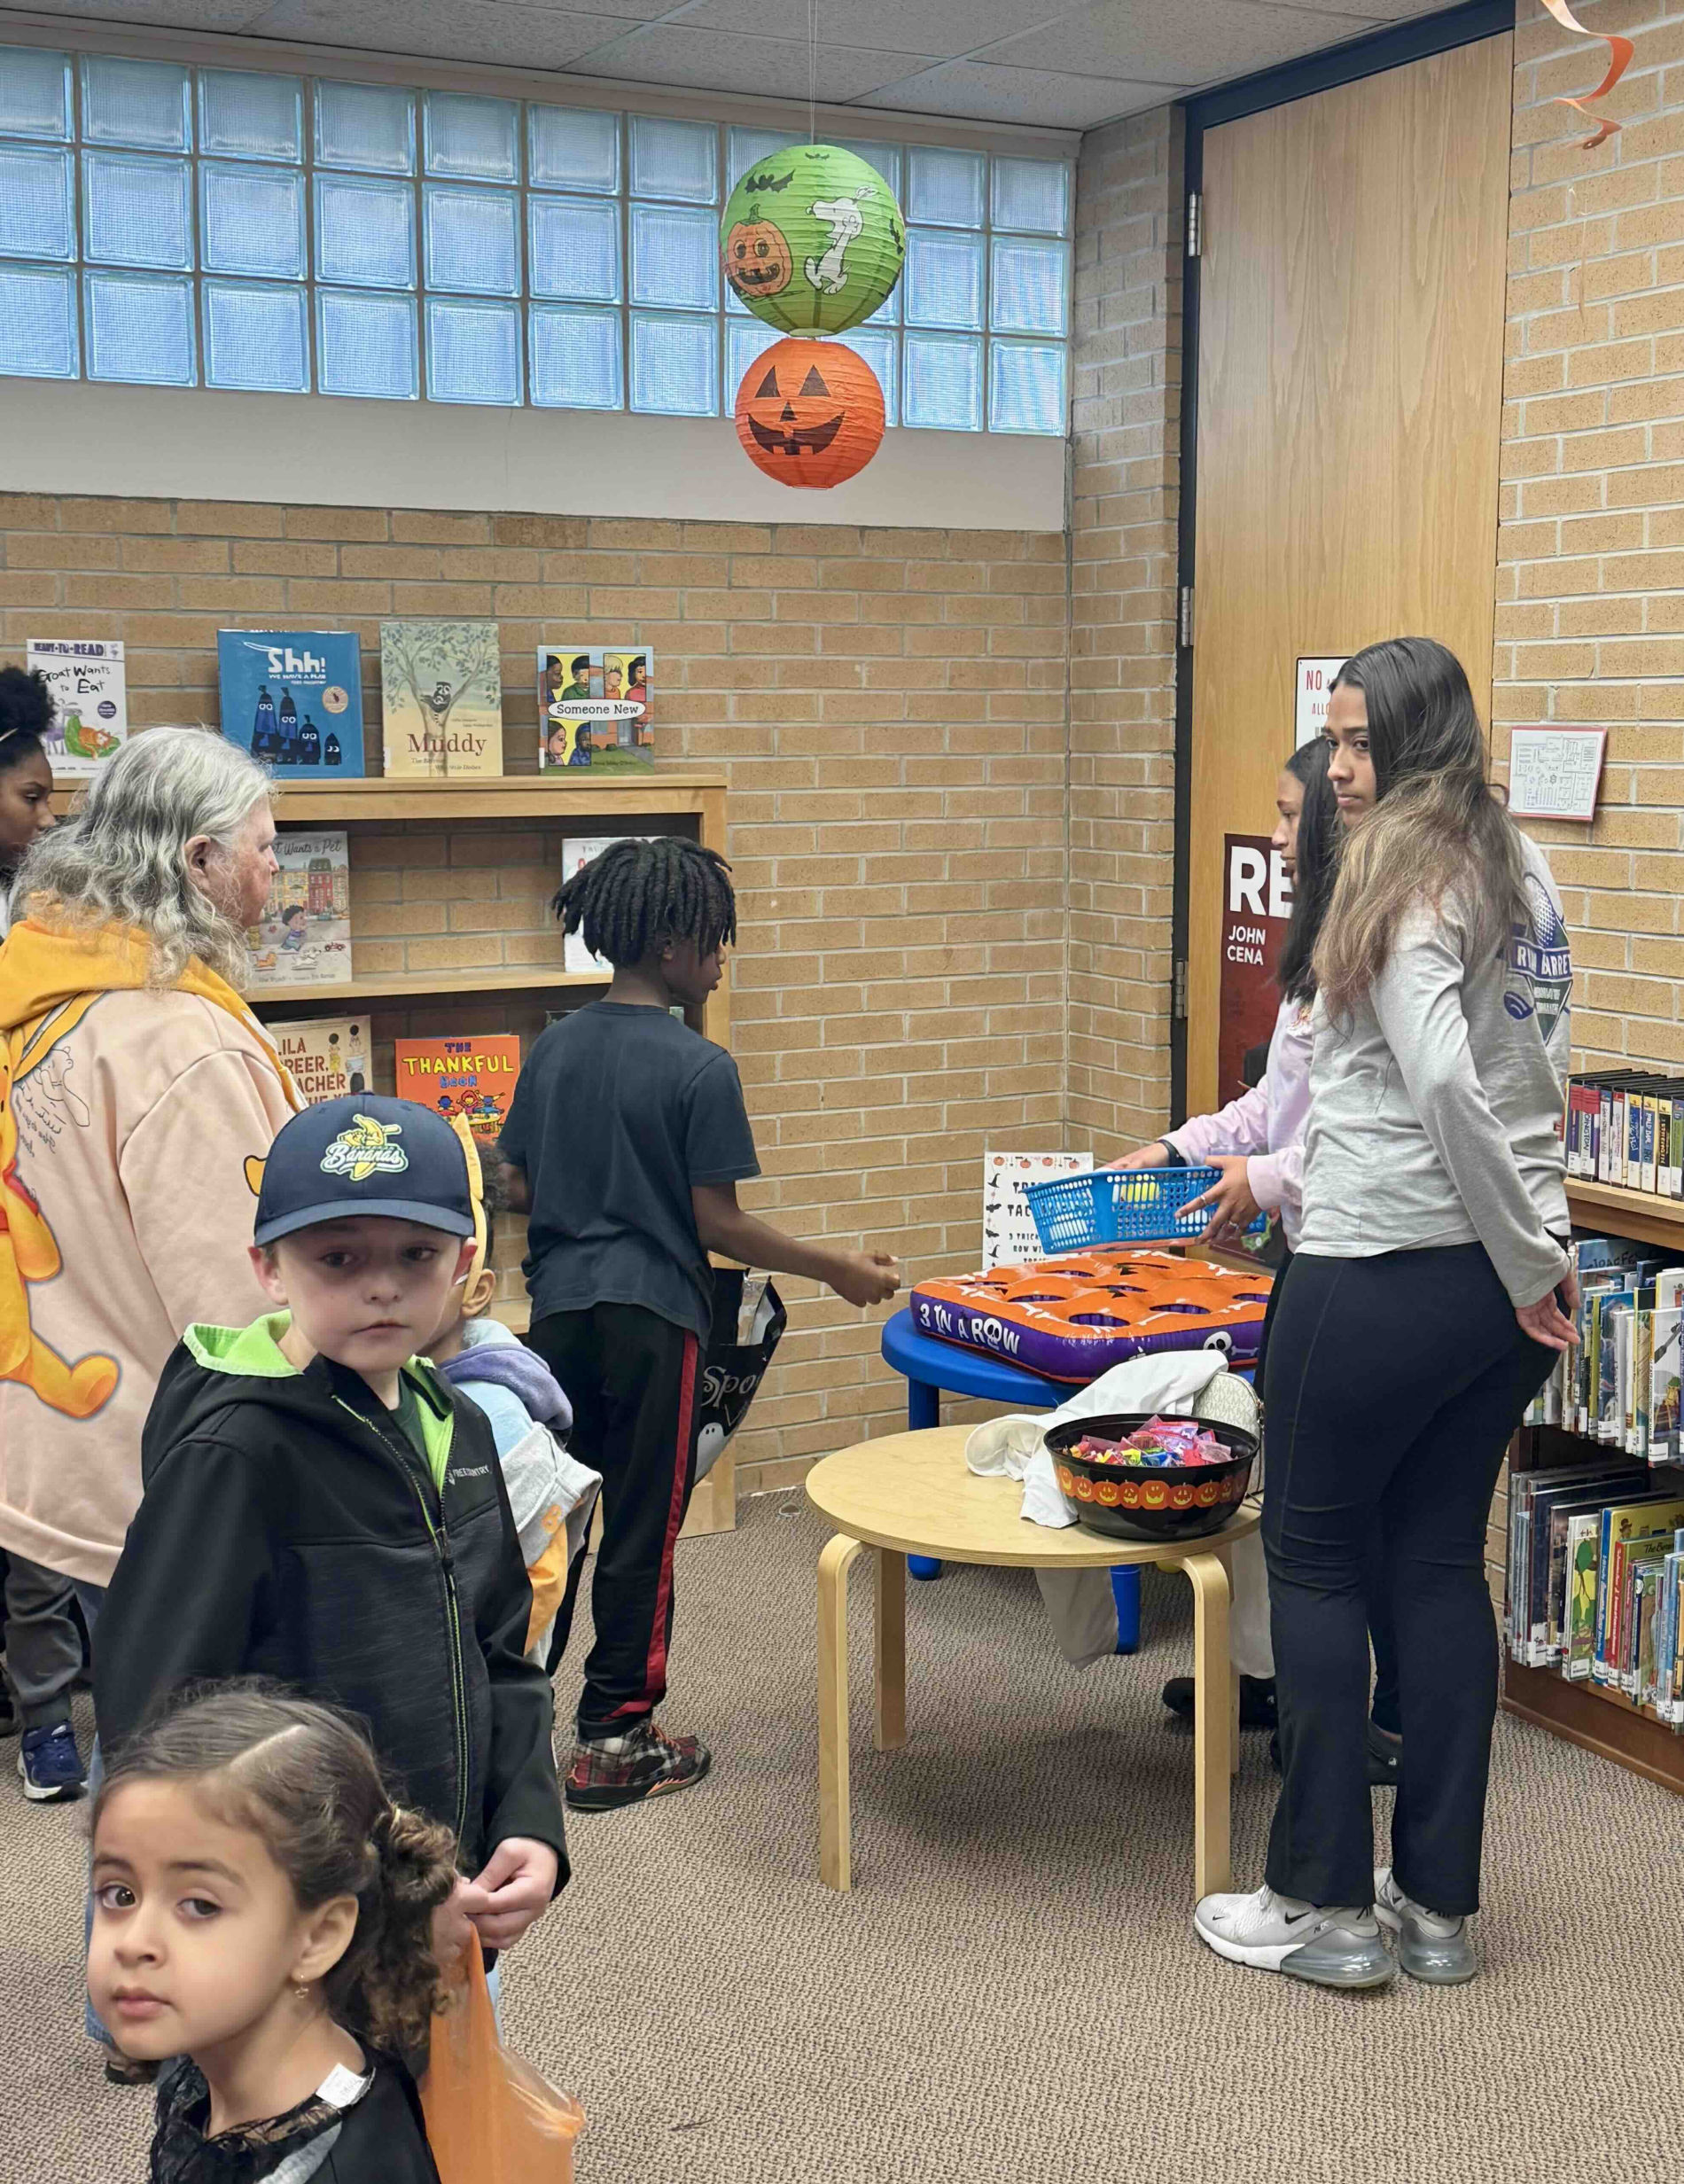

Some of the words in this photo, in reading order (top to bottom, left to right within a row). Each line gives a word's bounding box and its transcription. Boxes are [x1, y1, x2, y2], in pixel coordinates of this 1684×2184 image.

[73, 665, 111, 677] Wants
[267, 647, 326, 674] Shh!
[77, 678, 105, 694] Eat
[1306, 669, 1322, 690] NO
[557, 704, 610, 714] Someone
[613, 704, 639, 714] New
[406, 733, 487, 757] Muddy
[321, 838, 341, 854] Pet
[1228, 924, 1267, 946] JOHN
[1227, 945, 1264, 966] CENA
[277, 1037, 307, 1057] ILA
[444, 1041, 472, 1054] THE
[280, 1055, 330, 1075] REER,
[402, 1055, 515, 1076] THANKFUL
[324, 1143, 402, 1168] Bananas
[919, 1303, 932, 1328] 3
[933, 1304, 953, 1336] IN
[957, 1318, 970, 1339] A
[971, 1317, 1020, 1355] ROW
